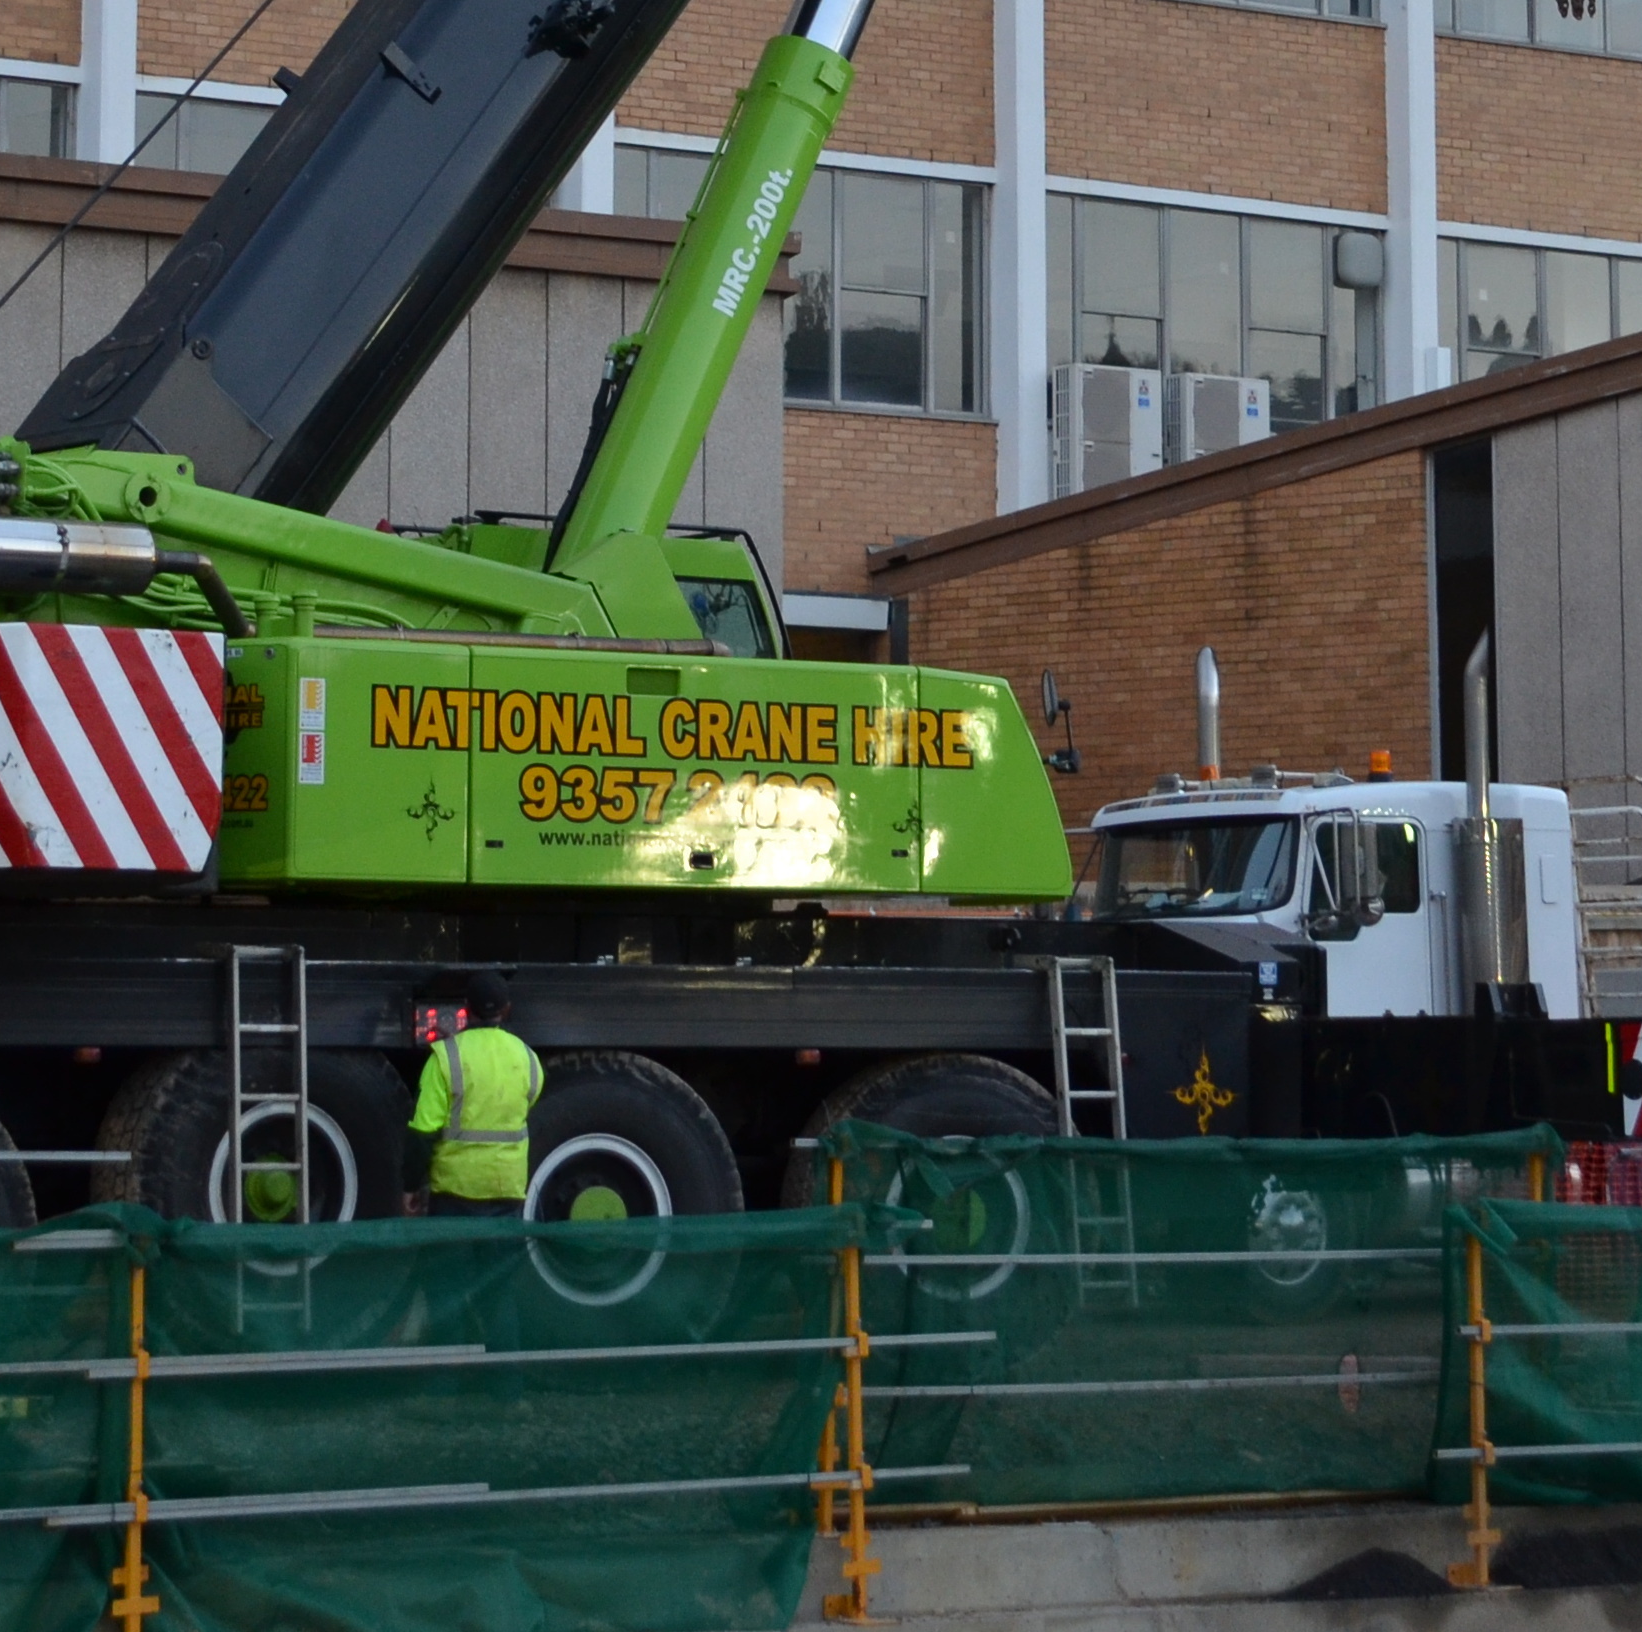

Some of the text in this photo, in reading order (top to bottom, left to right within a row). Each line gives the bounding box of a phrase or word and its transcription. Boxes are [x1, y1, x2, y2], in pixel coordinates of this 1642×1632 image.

[370, 684, 647, 757] NATIONAL
[659, 696, 840, 765] CRANE
[852, 706, 974, 769] HIRE
[519, 764, 677, 824] 9357
